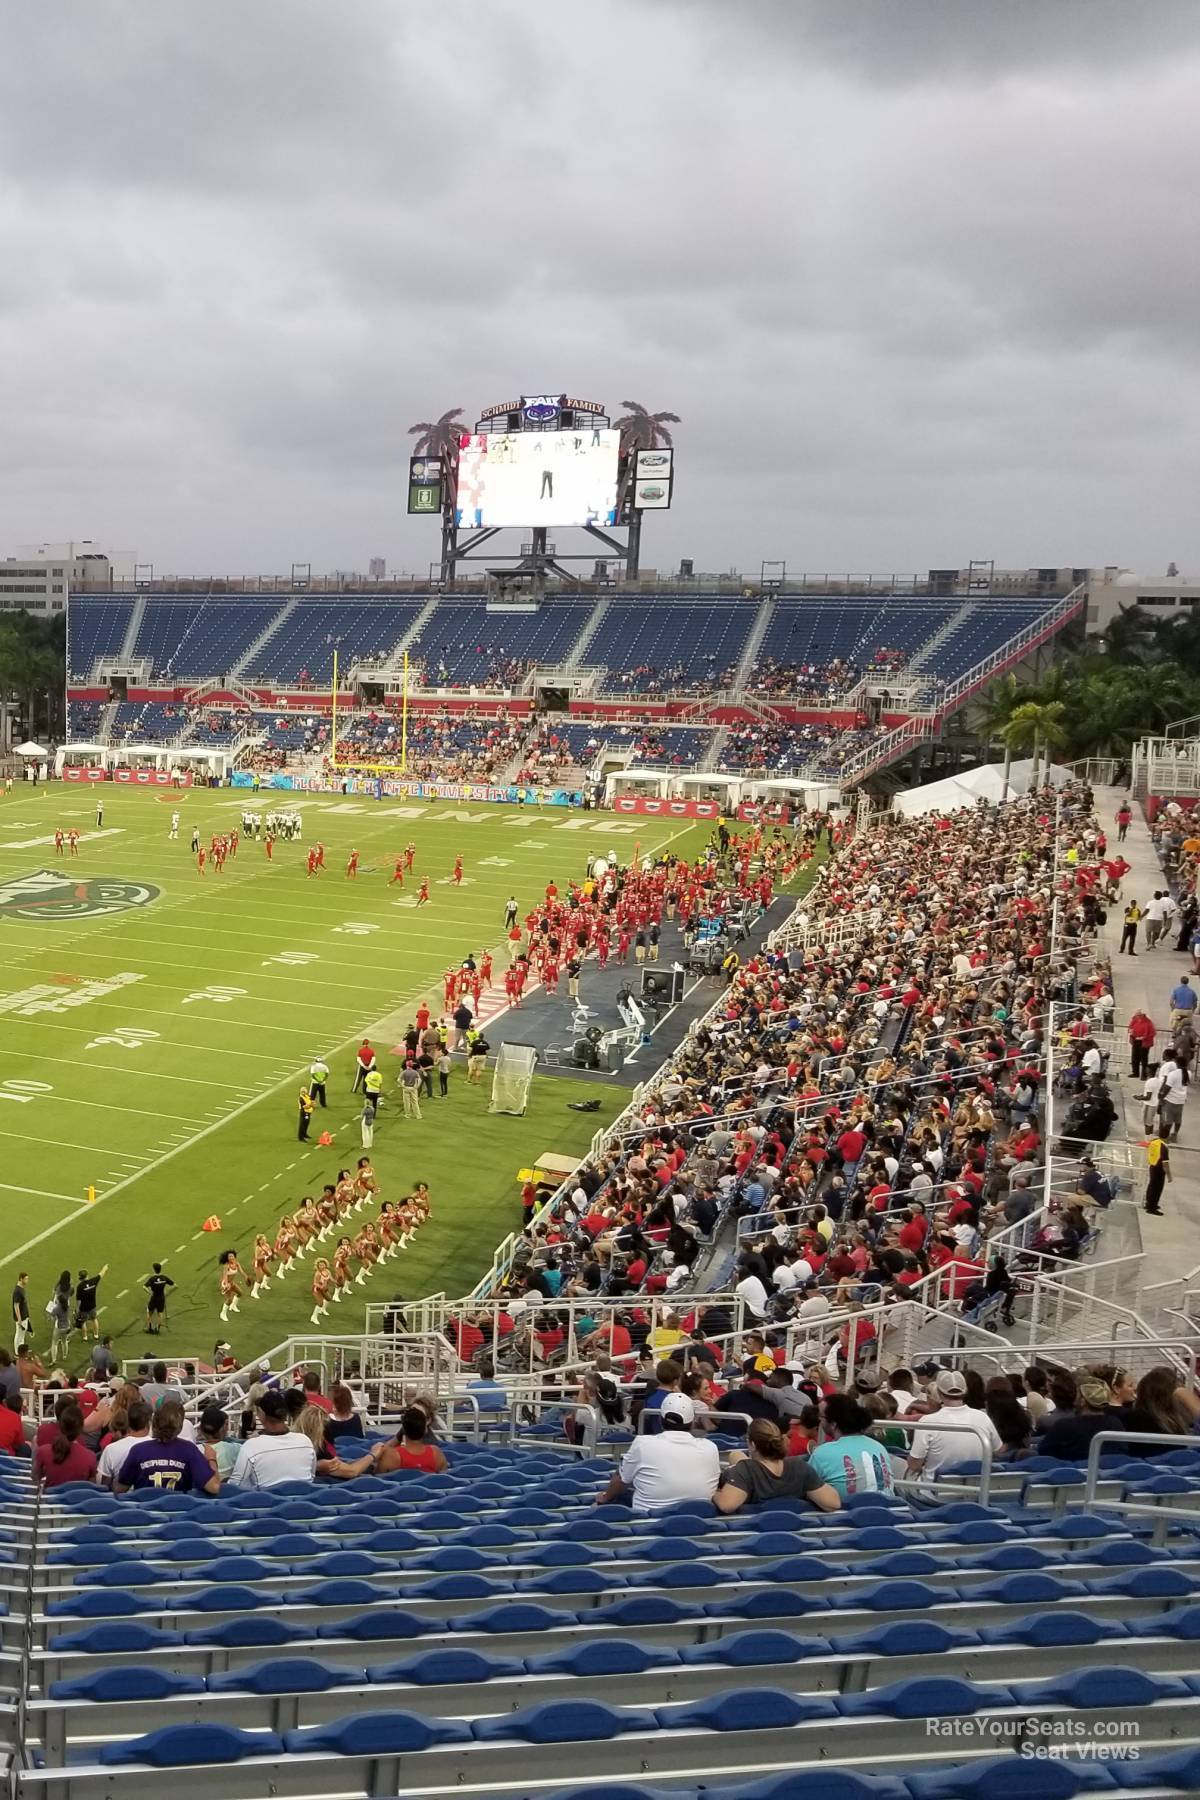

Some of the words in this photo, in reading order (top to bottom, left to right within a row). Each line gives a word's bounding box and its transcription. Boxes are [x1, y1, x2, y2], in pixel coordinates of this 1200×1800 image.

[482, 401, 521, 418] SCHMIDT
[524, 396, 561, 408] FAU
[567, 399, 603, 413] FAMILY
[214, 797, 649, 834] ATLANTIC
[275, 951, 321, 966] 40
[190, 985, 249, 1003] 30
[96, 1026, 161, 1049] 20
[148, 1471, 182, 1492] 17
